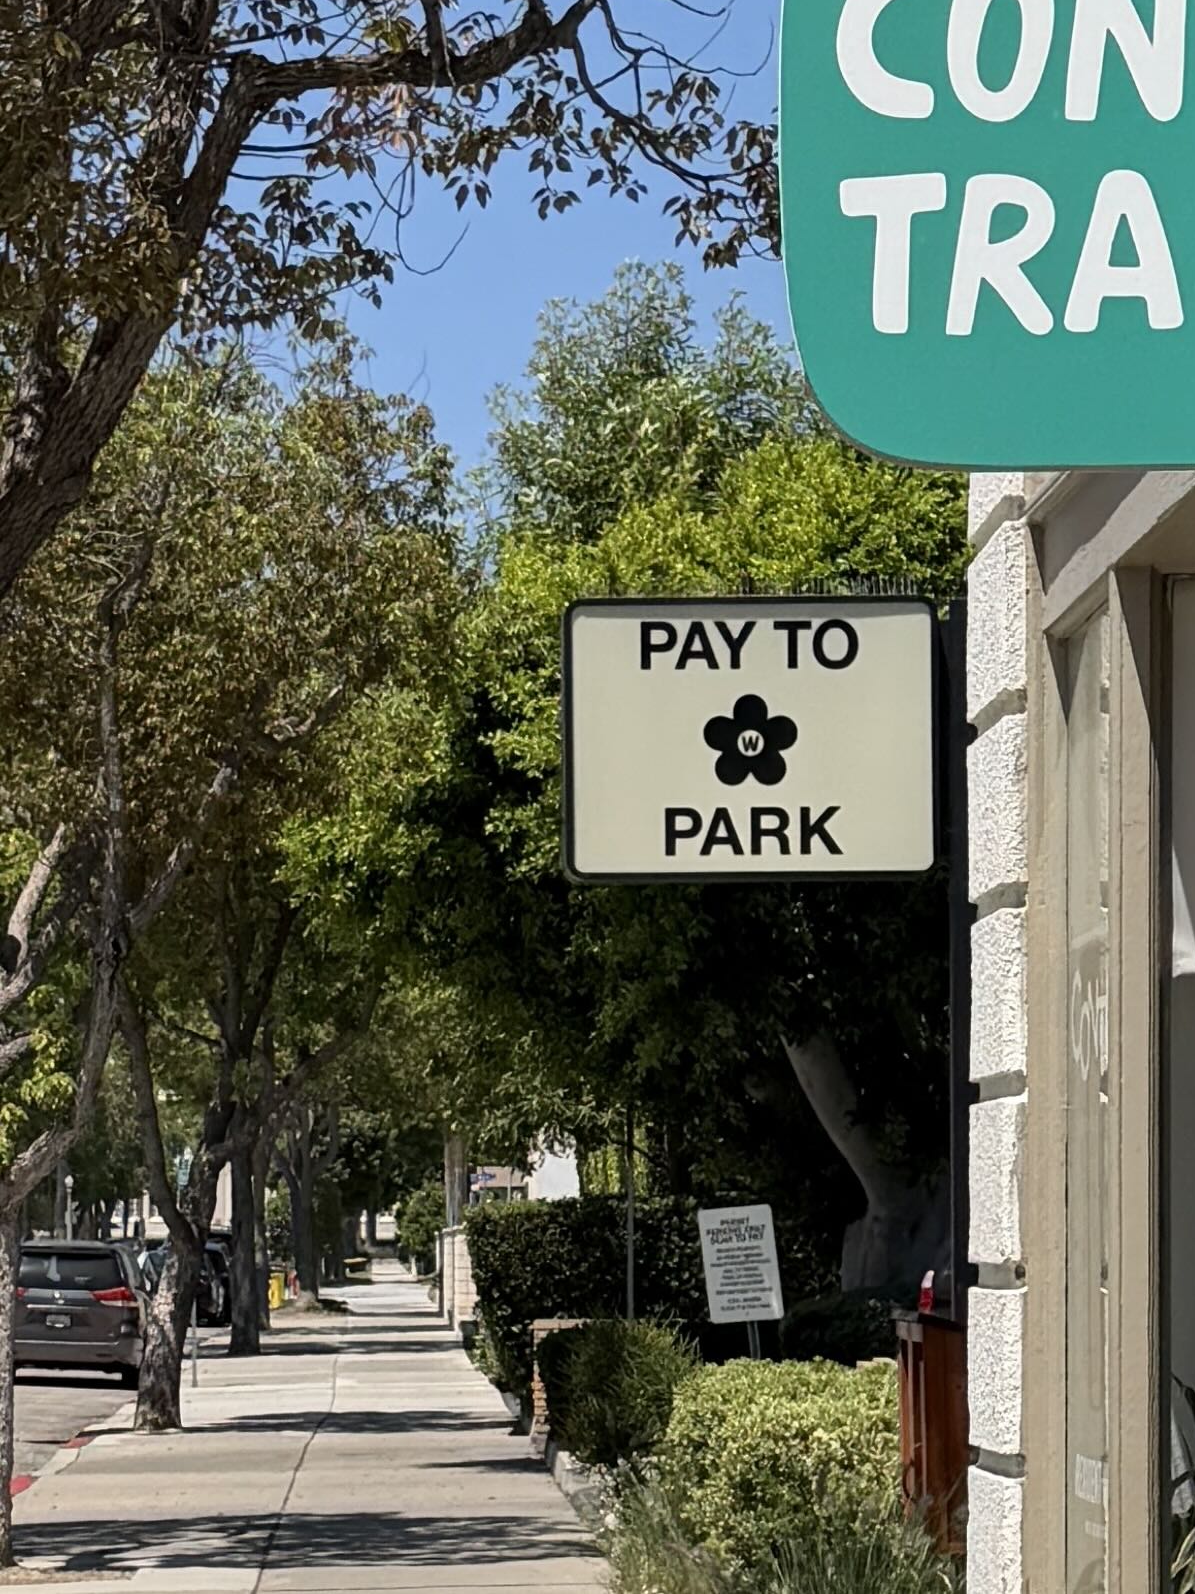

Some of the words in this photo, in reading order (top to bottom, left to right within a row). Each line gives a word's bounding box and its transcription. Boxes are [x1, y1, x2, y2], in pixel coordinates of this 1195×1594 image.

[839, 169, 1185, 336] TRA
[640, 620, 757, 671] PAY
[773, 618, 859, 670] TO
[740, 734, 760, 753] W
[664, 806, 844, 857] PARK
